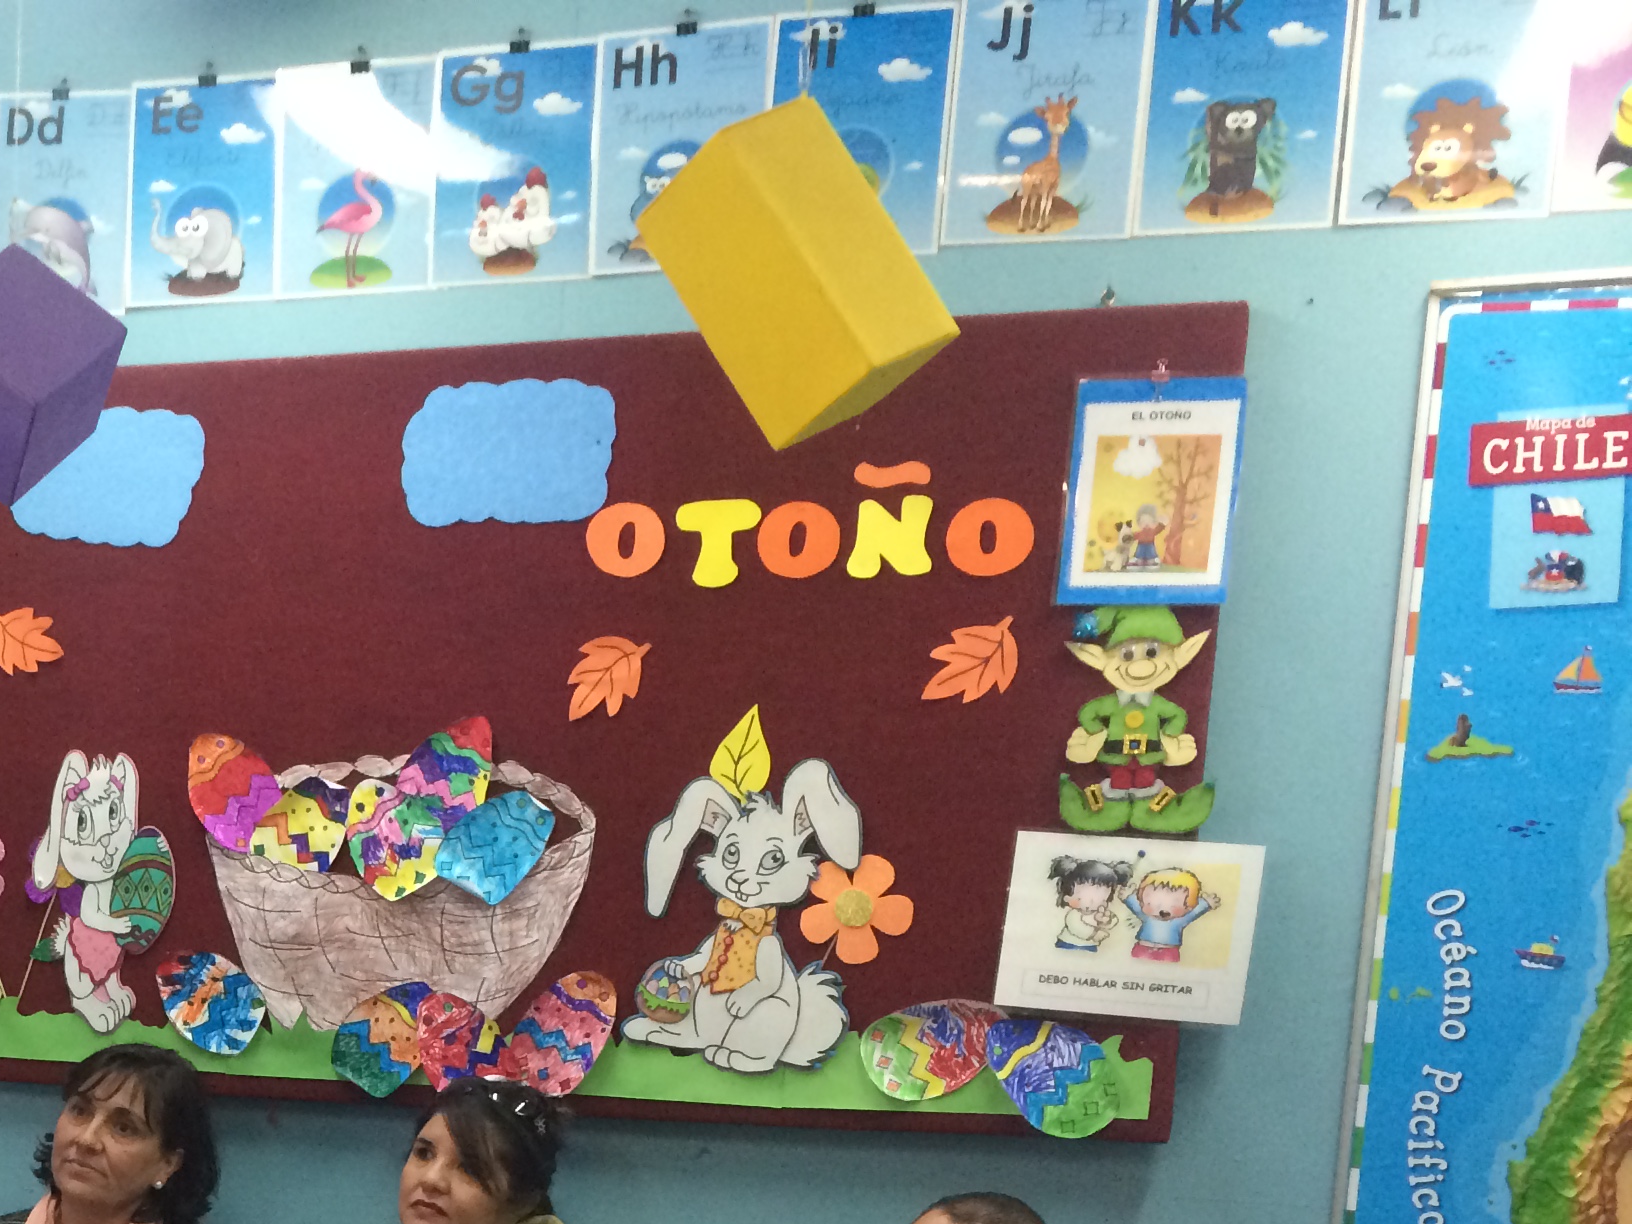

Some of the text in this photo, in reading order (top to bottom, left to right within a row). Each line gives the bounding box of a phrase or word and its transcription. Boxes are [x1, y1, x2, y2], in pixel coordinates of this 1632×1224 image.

[986, 3, 1035, 62] Jj
[613, 43, 678, 89] Hh
[451, 64, 525, 114] Gg
[7, 106, 65, 146] Dd
[151, 95, 204, 134] Ee
[1526, 415, 1596, 434] Mapa de
[1483, 430, 1629, 475] CHILE
[586, 460, 1035, 588] OTOÑO
[1038, 974, 1193, 996] DEBO HABLAR SIN GRITAR
[1425, 889, 1477, 1041] Océano
